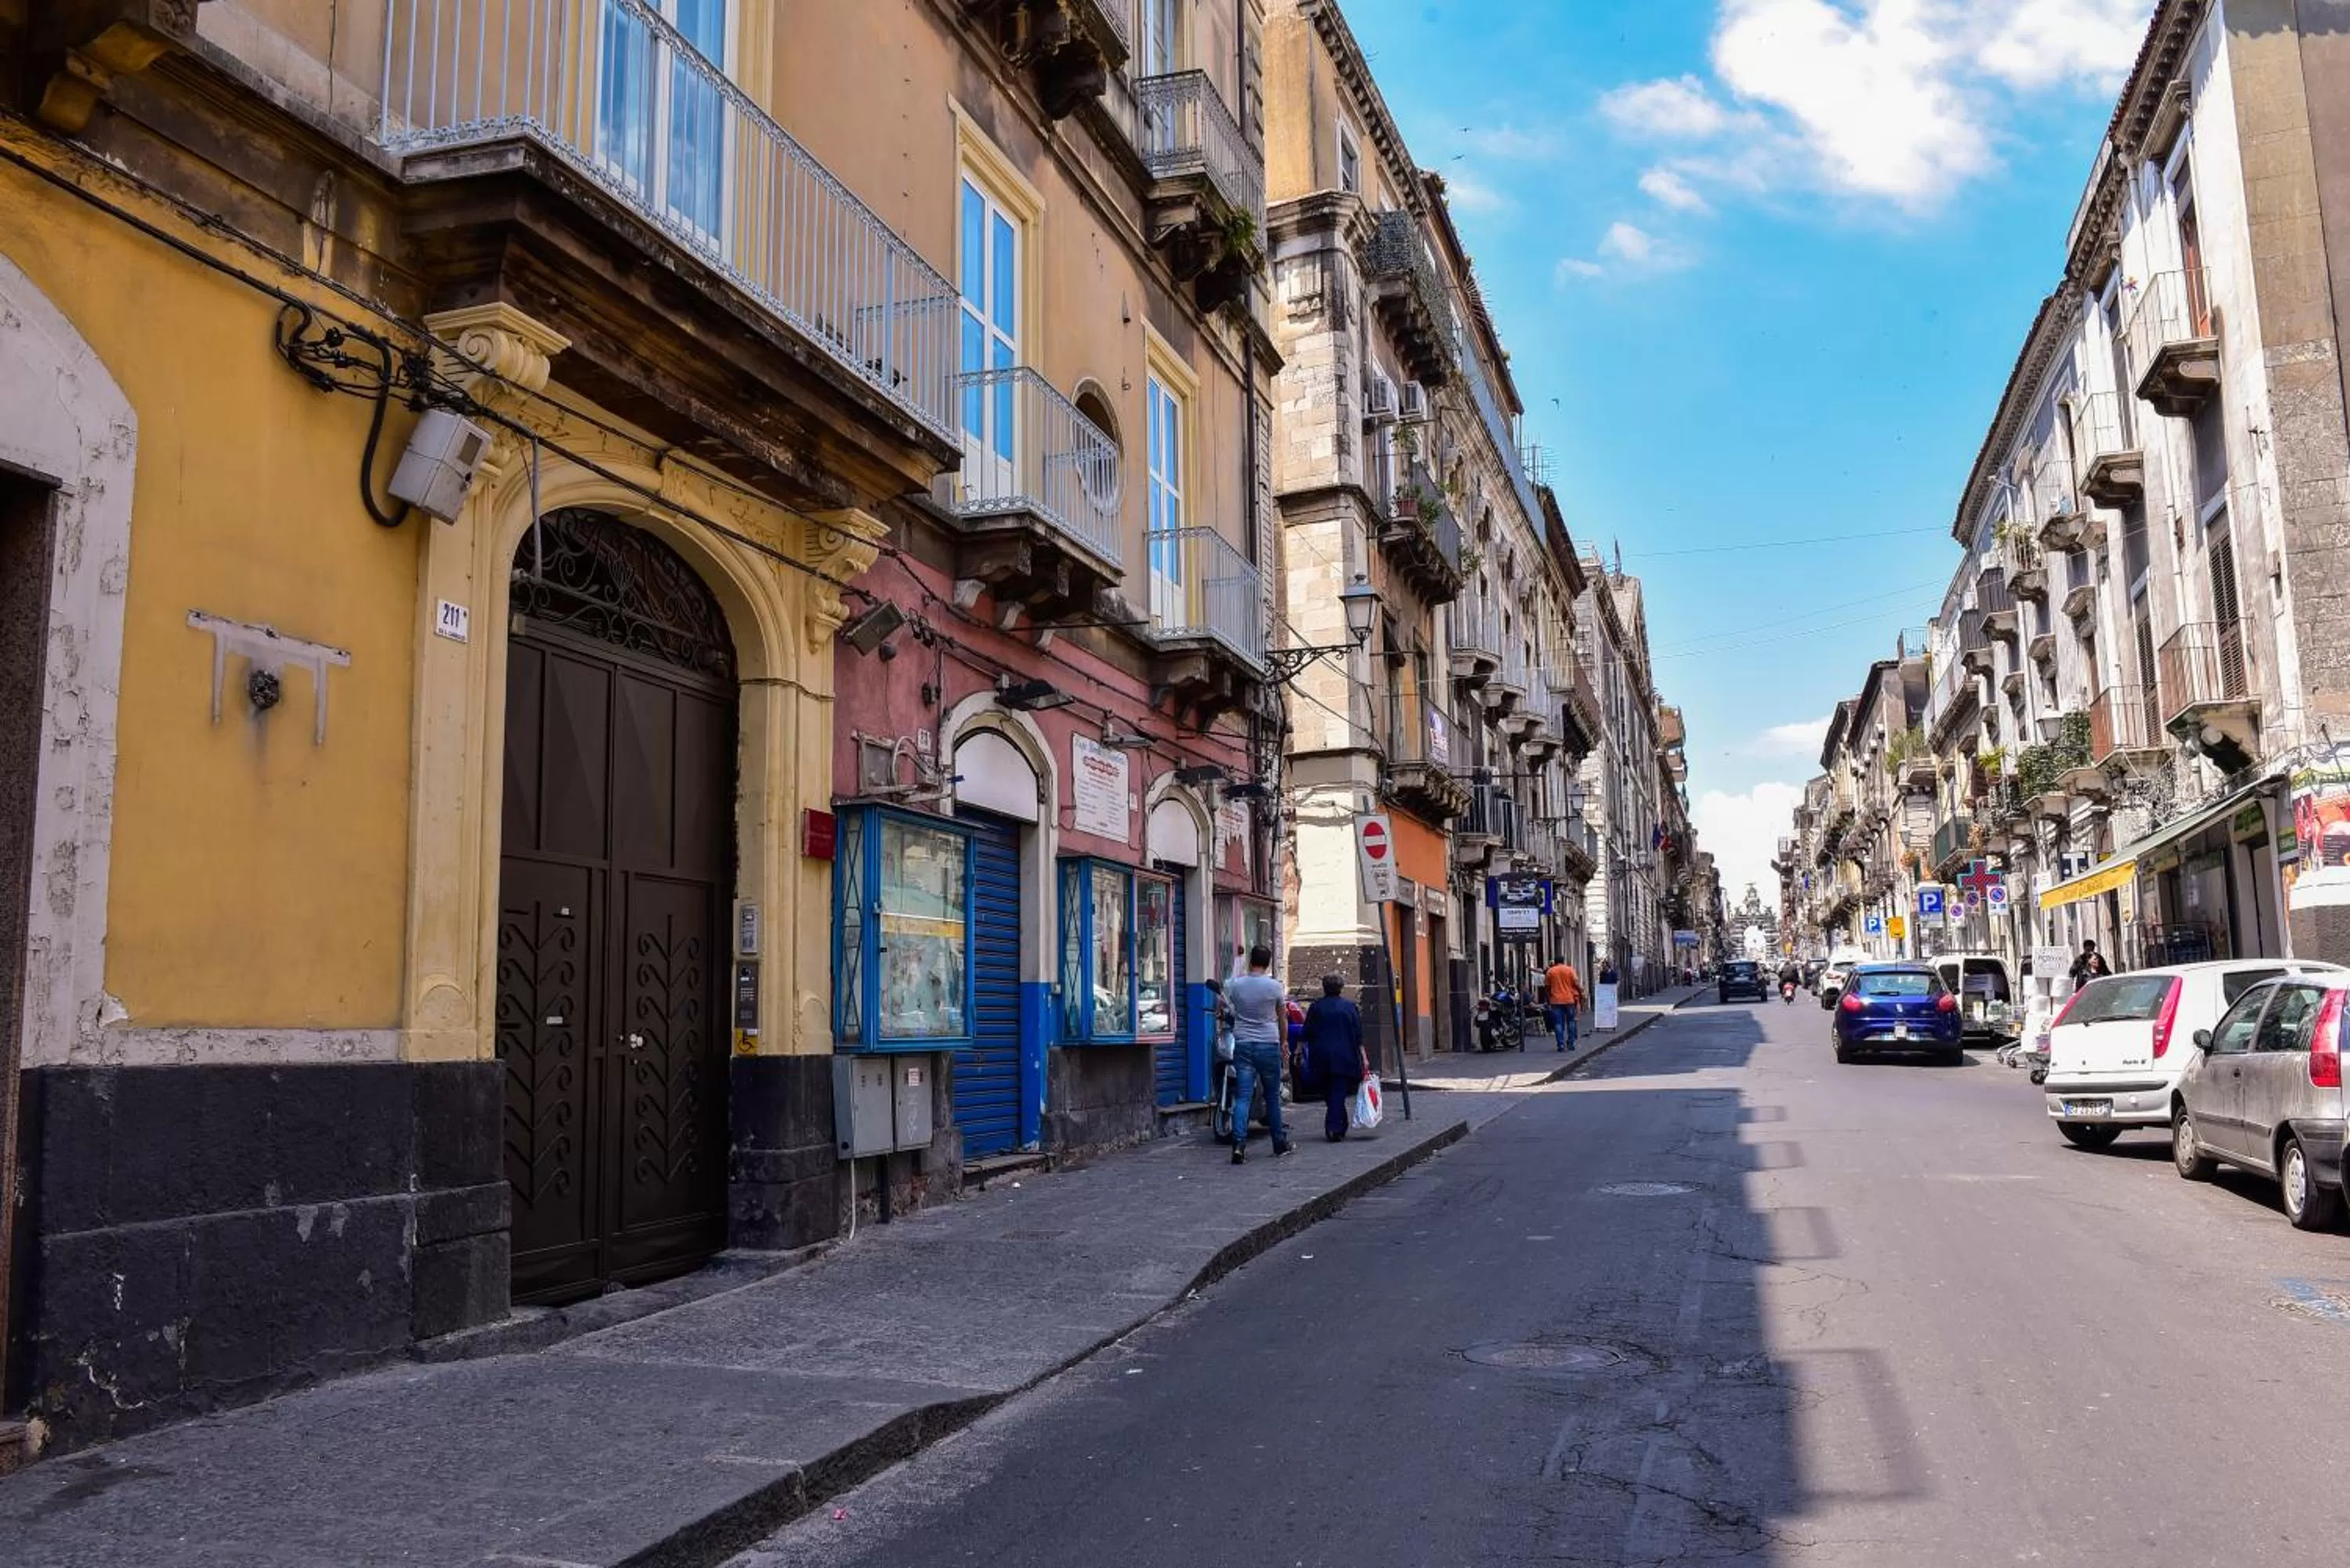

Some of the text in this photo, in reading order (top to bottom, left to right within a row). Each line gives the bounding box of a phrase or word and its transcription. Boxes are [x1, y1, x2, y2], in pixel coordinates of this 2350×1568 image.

[443, 603, 460, 627] 211
[1924, 894, 1936, 911] P
[1868, 919, 1877, 930] P
